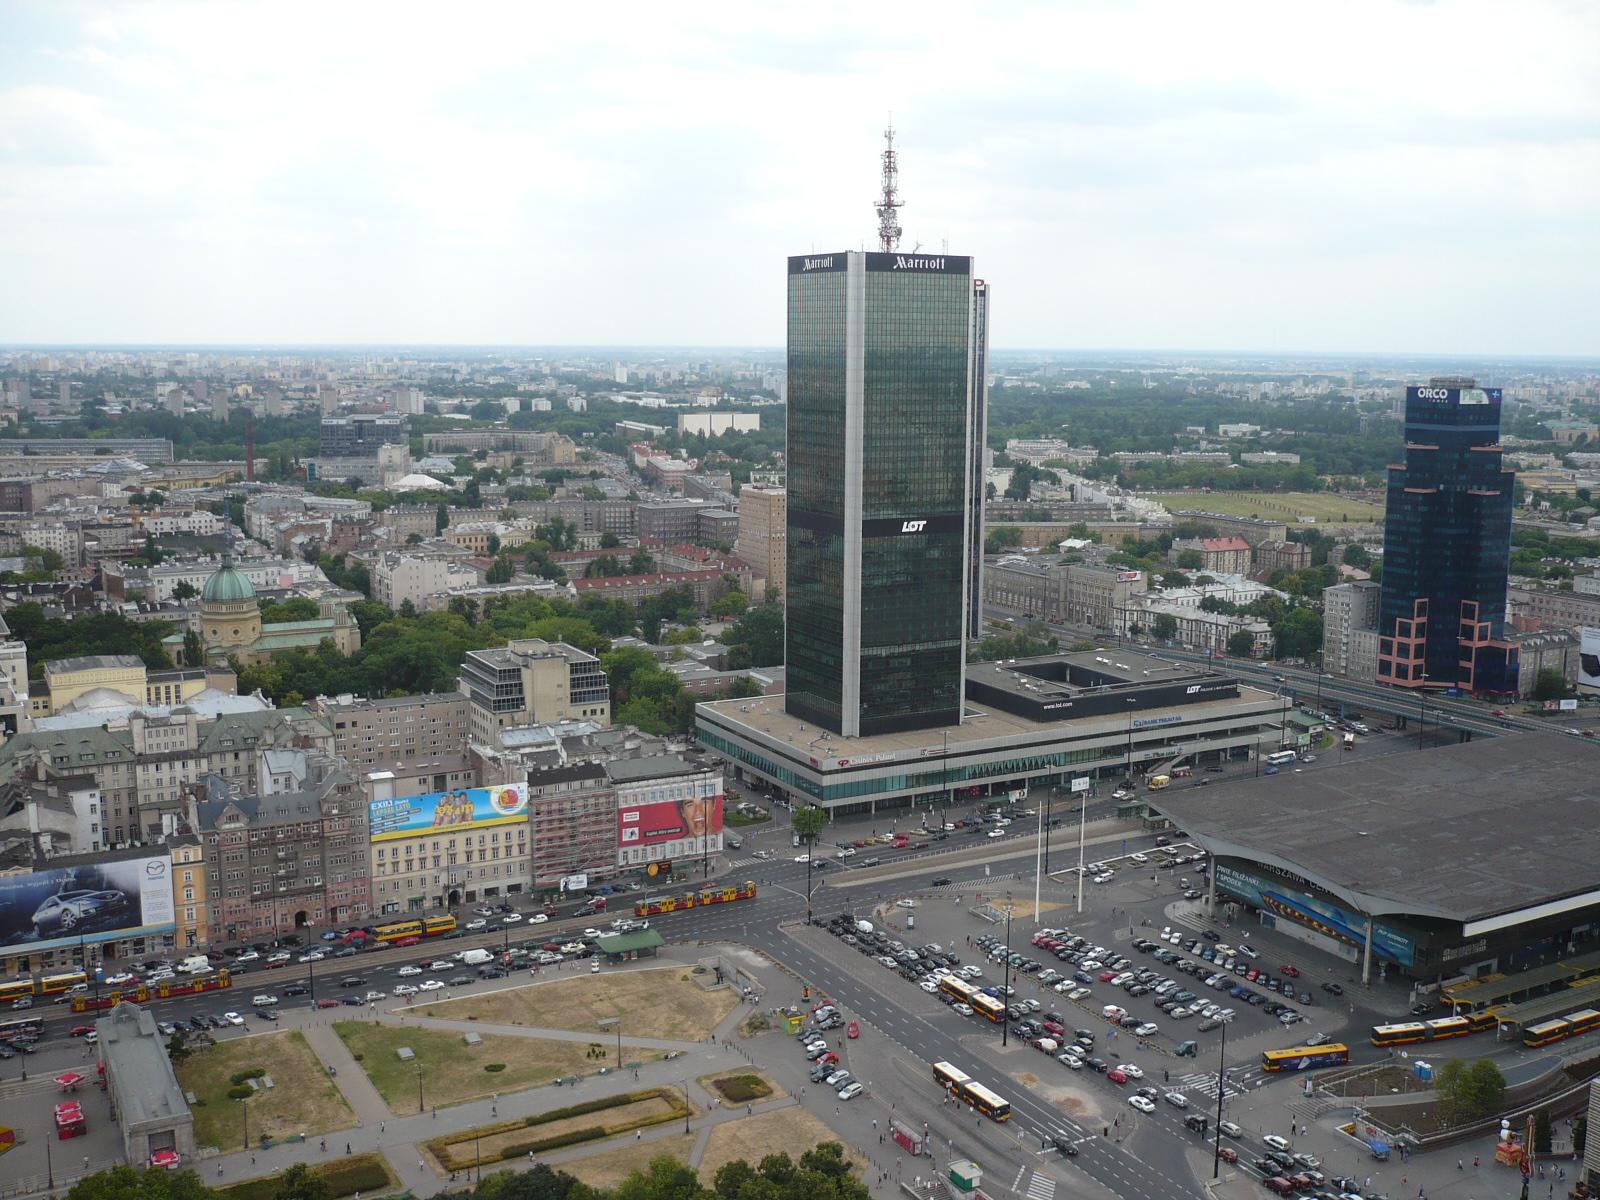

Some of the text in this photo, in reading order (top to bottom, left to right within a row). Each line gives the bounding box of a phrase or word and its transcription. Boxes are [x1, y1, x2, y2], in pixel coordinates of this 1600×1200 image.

[802, 256, 833, 272] Marriott
[893, 256, 945, 270] Marriott
[1417, 387, 1448, 399] ORCO
[901, 520, 927, 533] LOT
[1186, 685, 1201, 694] LOT
[1043, 702, 1073, 710] www.lot.com
